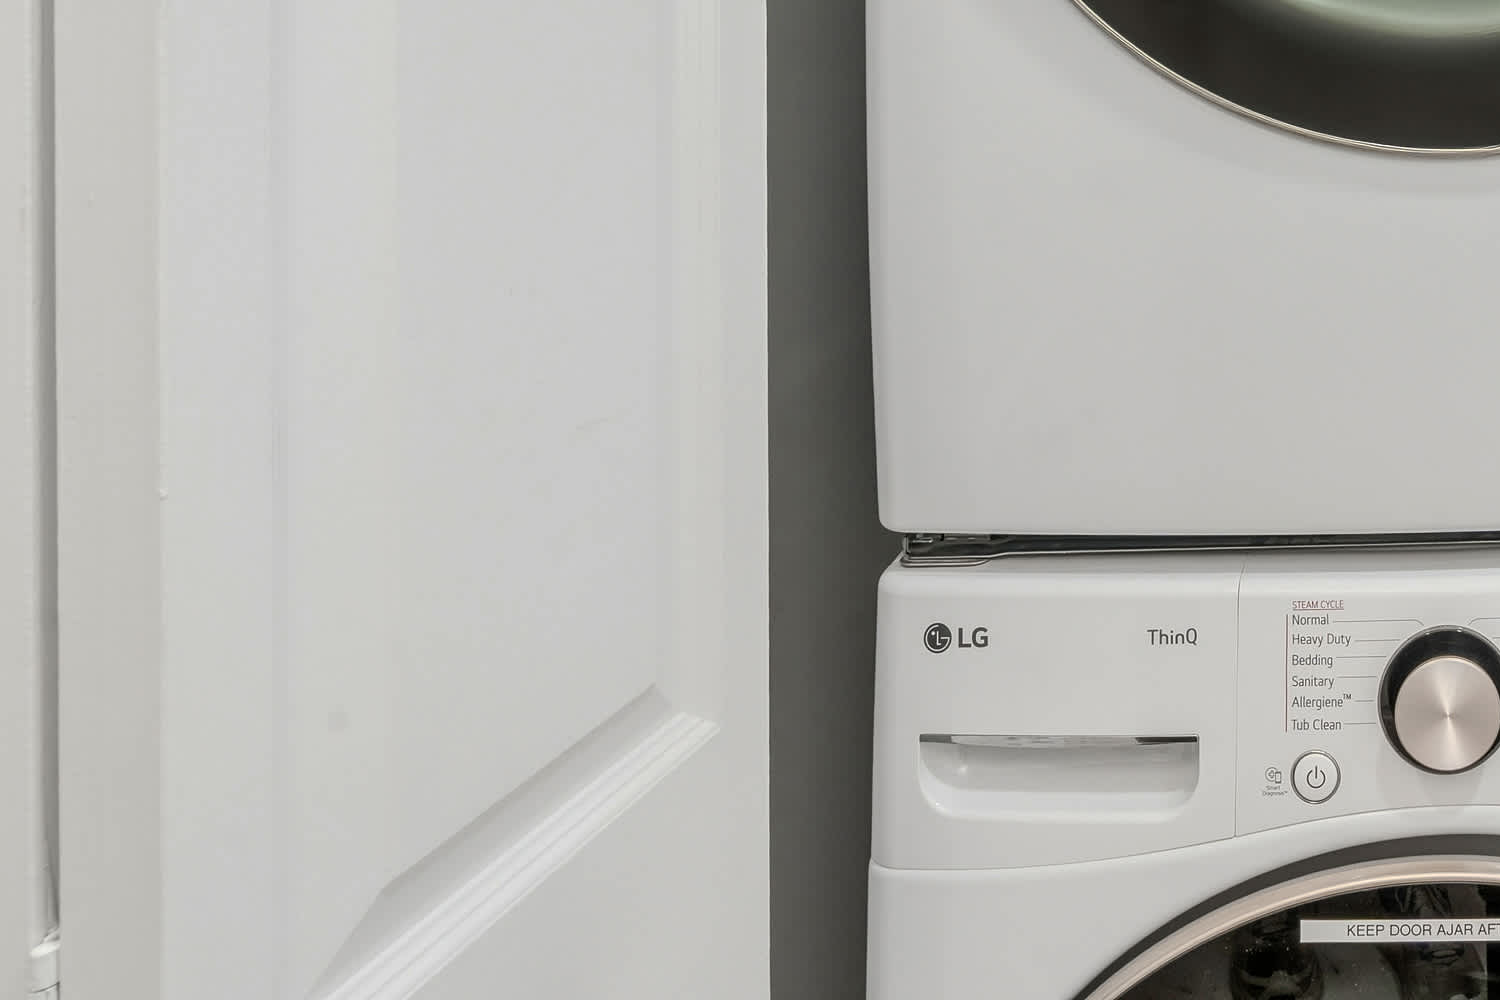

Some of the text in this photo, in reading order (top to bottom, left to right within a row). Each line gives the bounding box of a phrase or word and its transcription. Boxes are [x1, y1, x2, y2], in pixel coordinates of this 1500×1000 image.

[1292, 600, 1344, 609] STEAM CYCLE
[1292, 614, 1329, 625] Normal
[958, 627, 989, 648] LG
[1147, 628, 1197, 645] ThinQ
[1292, 634, 1351, 648] Heavy Duty
[1292, 654, 1333, 668] Bedding
[1292, 675, 1334, 689] Sanitary
[1292, 719, 1341, 731] Tub Clean
[1347, 924, 1385, 937] KEEP
[1389, 924, 1432, 936] DOOR
[1437, 923, 1473, 936] AJAR
